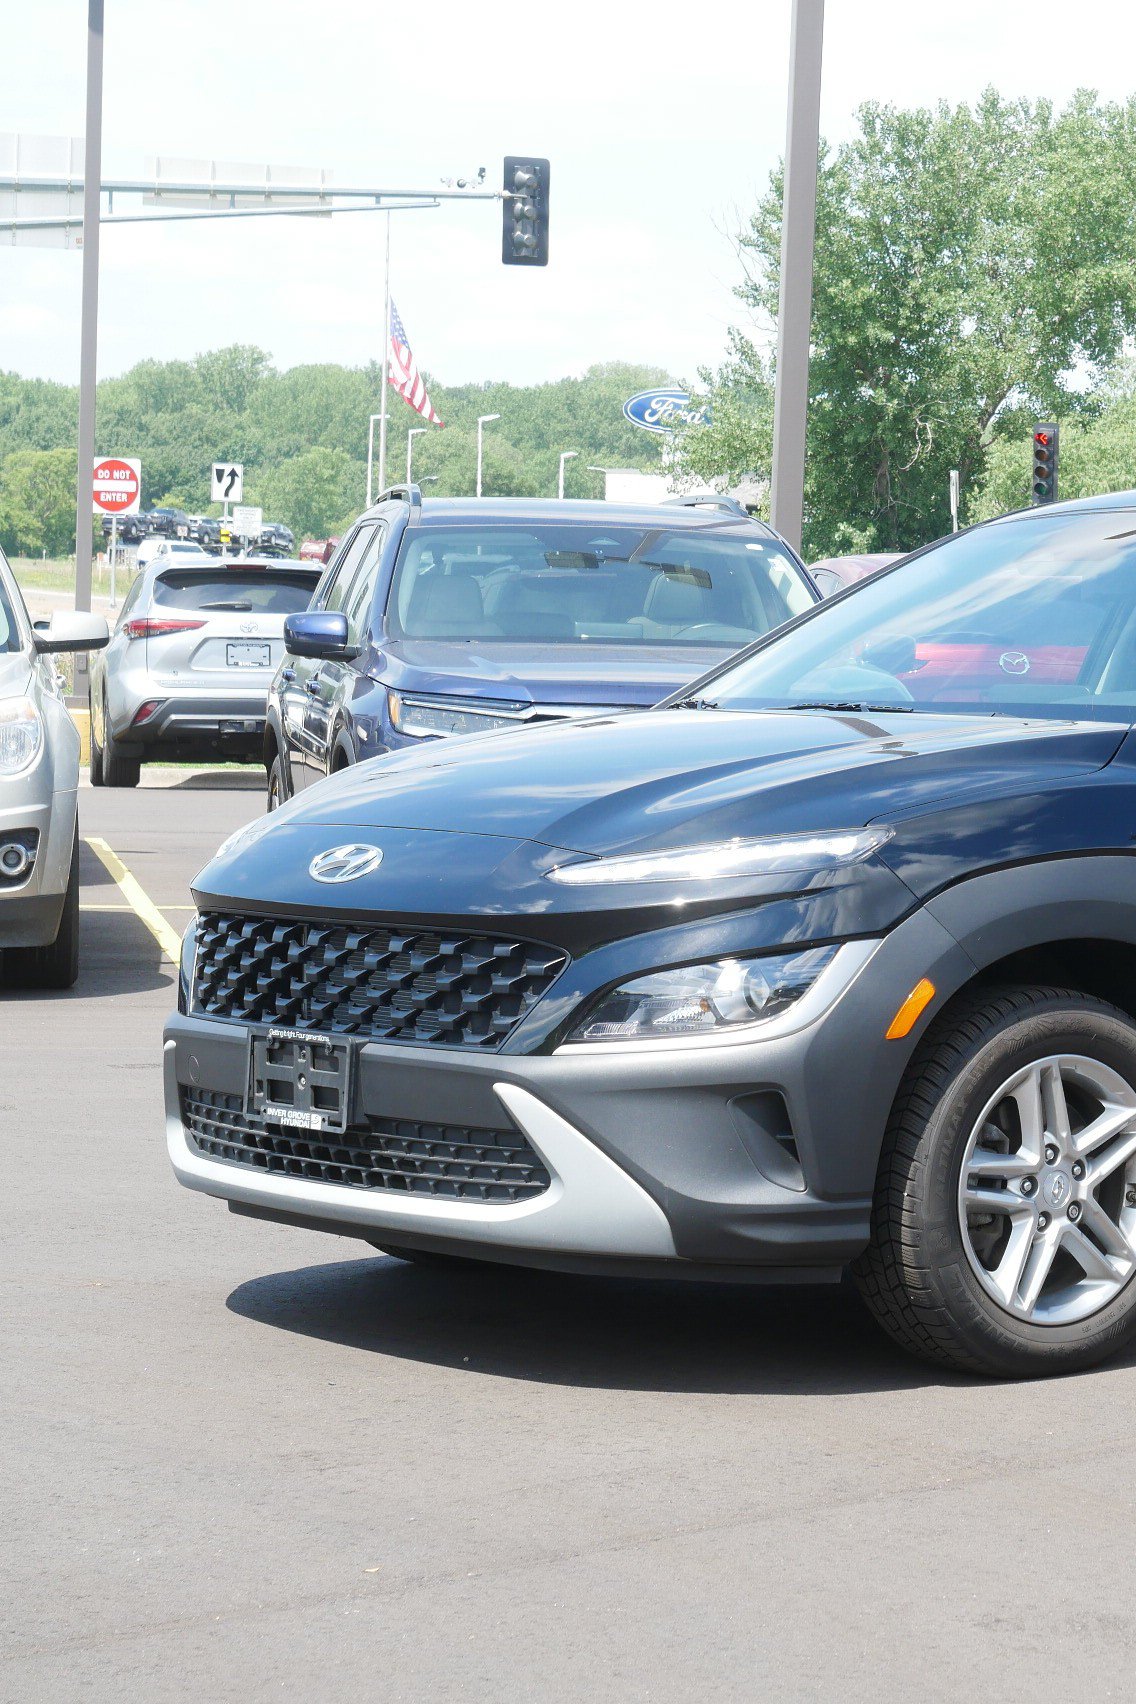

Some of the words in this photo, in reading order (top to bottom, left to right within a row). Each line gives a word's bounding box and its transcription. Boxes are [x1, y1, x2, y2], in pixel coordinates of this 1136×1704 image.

[97, 469, 110, 479] DO
[113, 470, 131, 480] NOT
[100, 492, 128, 503] ENTER
[267, 1107, 287, 1118] INVER
[288, 1110, 311, 1121] GROVE
[280, 1117, 310, 1129] HYUNDAI
